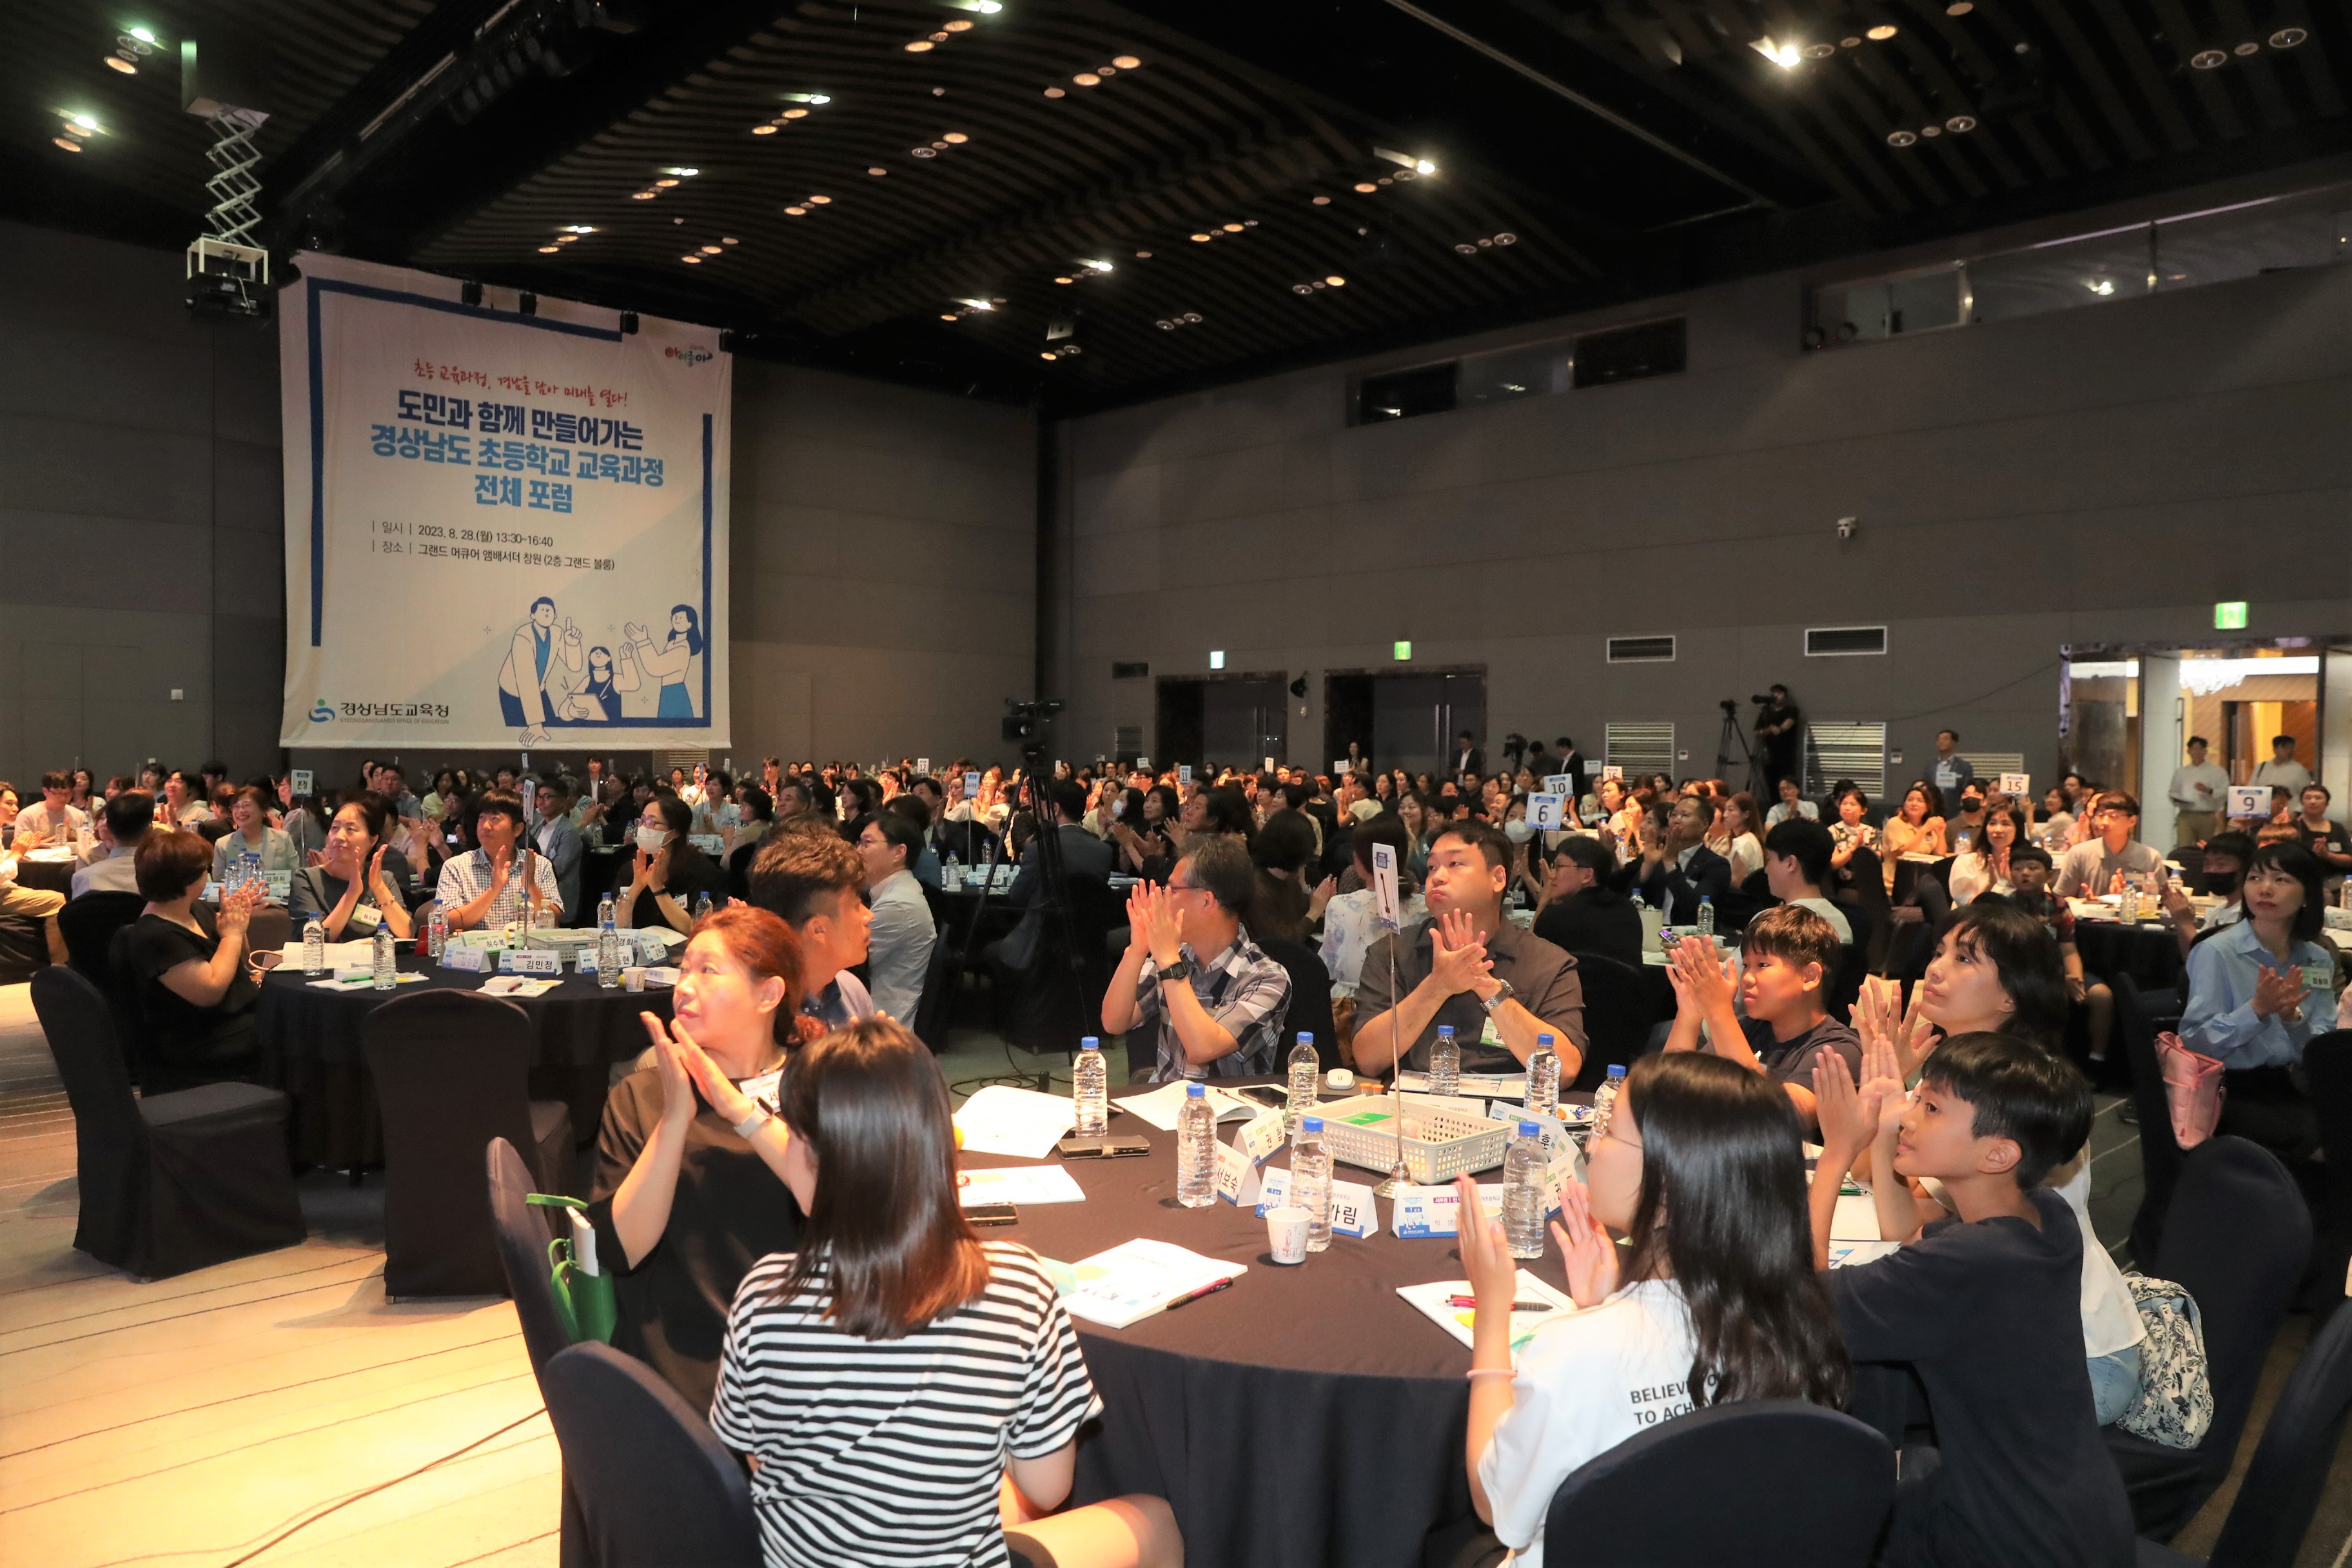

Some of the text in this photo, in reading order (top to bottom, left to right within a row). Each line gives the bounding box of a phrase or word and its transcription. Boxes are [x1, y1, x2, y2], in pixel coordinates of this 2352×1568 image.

[415, 358, 435, 380] 초등
[498, 375, 531, 395] 경남을
[535, 381, 558, 395] 담아
[564, 386, 595, 406] 미래를
[600, 389, 627, 407] 열다!
[398, 389, 643, 451] 도민과 함께 만들어가는
[371, 424, 663, 487] 경상남도 초등학교 교육과정
[474, 474, 573, 513] 전체 포럼
[382, 522, 403, 535] 일시
[418, 525, 446, 538] 2023.
[449, 529, 458, 539] 8.
[496, 533, 553, 547] 13:30~16:40
[382, 541, 615, 571] 장소 그랜드 머큐어 앰배서더 창원 (2층 그랜드 볼룸)
[340, 702, 449, 718] 경상남도교육청
[297, 780, 308, 790] 본청
[1182, 772, 1188, 781] 11
[2007, 781, 2023, 792] 15
[1551, 783, 1566, 794] 10
[1538, 805, 1549, 823] 6
[2243, 796, 2255, 812] 9
[1380, 873, 1391, 913] 1
[486, 939, 505, 948] 허수복
[526, 960, 553, 970] 김민정
[1217, 1166, 1238, 1193] 서보숙
[1332, 1204, 1357, 1225] 가림
[1631, 1381, 1688, 1404] BELIEV
[1634, 1402, 1694, 1425] TO ACH
